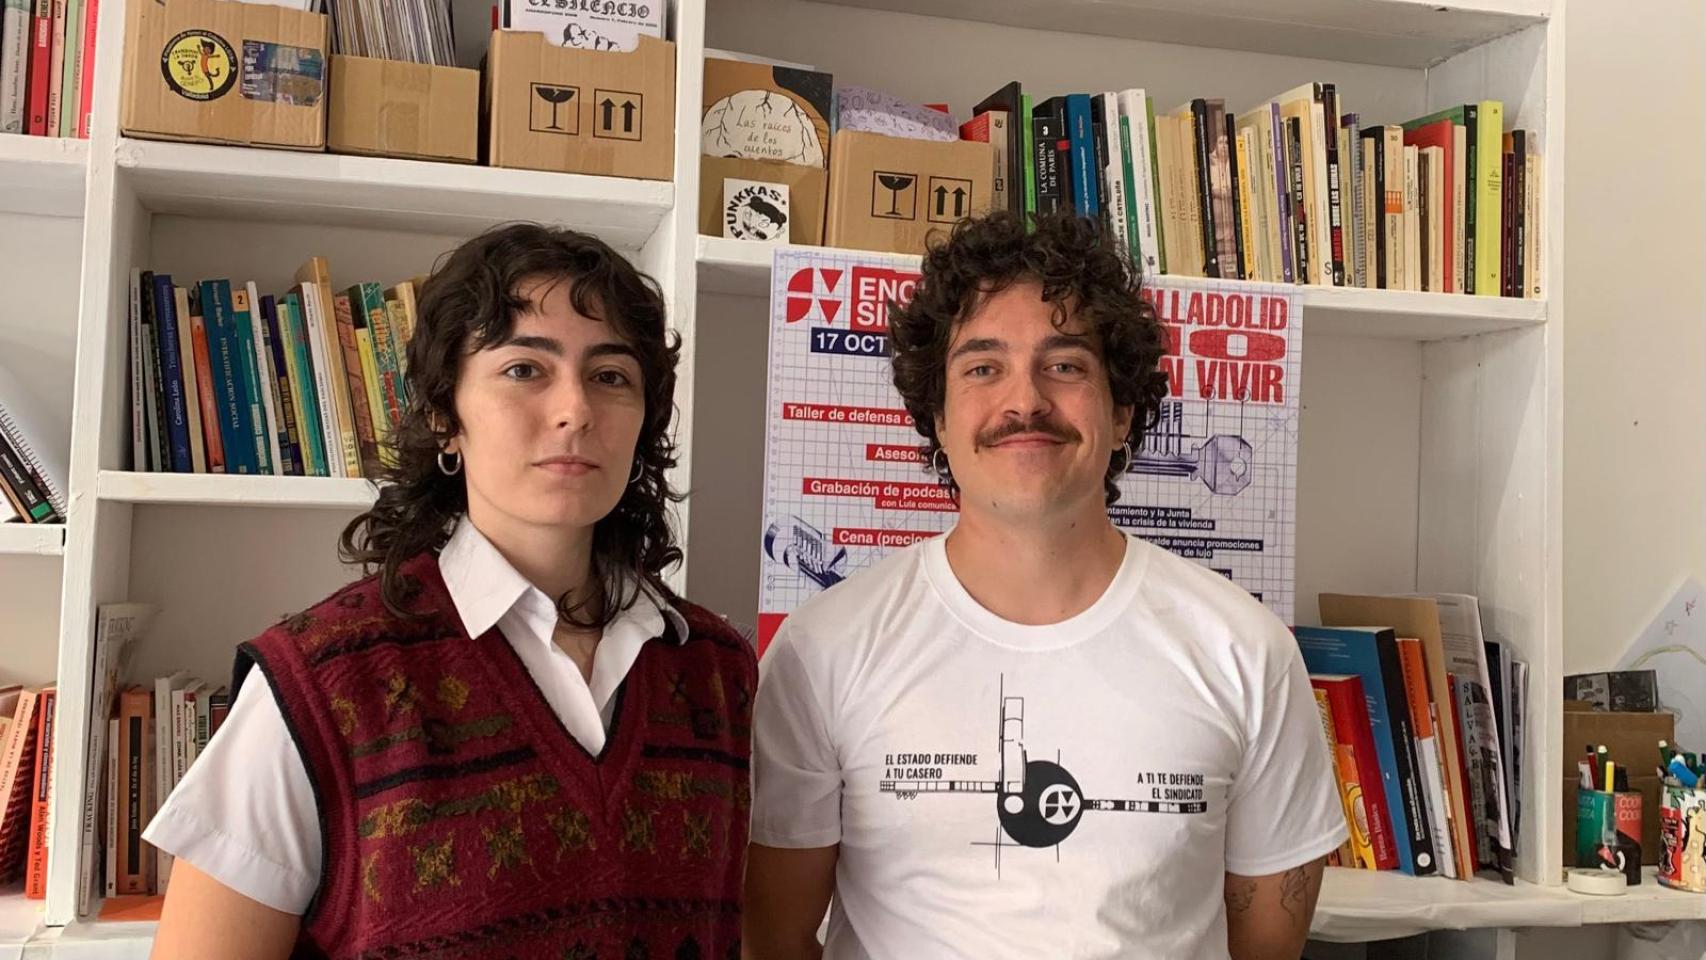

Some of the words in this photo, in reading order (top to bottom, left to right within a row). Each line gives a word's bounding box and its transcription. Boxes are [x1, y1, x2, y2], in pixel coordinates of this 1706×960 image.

[736, 106, 756, 129] Las
[747, 132, 759, 142] de
[763, 135, 777, 145] los
[1039, 142, 1048, 180] COMUNA
[1048, 149, 1057, 172] PARÍS
[1041, 182, 1048, 193] LA
[1050, 175, 1057, 187] DE
[1330, 190, 1339, 203] LAS
[726, 186, 782, 240] PUNKKAS
[859, 277, 917, 302] ENC
[237, 294, 245, 305] 2
[857, 303, 886, 327] SI
[816, 333, 838, 350] 17
[844, 334, 888, 353] OCT
[170, 379, 180, 397] León
[1159, 358, 1184, 398] N
[1196, 359, 1284, 403] VIVIR
[172, 397, 183, 426] Carolina
[230, 402, 240, 430] SOCIAL
[787, 405, 825, 420] Taller
[828, 408, 845, 421] de
[849, 409, 901, 424] defensa
[904, 415, 914, 424] c
[874, 448, 920, 462] Aseso
[810, 480, 879, 496] Grabación
[883, 483, 899, 497] de
[903, 485, 955, 500] podcas
[881, 500, 897, 508] con
[1107, 507, 1148, 517] ntamiento
[1149, 510, 1156, 518] y
[1157, 509, 1165, 517] la
[1166, 509, 1190, 518] Junta
[1122, 516, 1130, 525] la
[1131, 517, 1156, 526] crisis
[1156, 518, 1168, 527] de
[1168, 518, 1177, 527] la
[1178, 519, 1213, 529] vivienda
[838, 530, 873, 545] Cena
[876, 531, 930, 547] (precio
[1172, 539, 1205, 548] anuncia
[1206, 540, 1260, 550] promociones
[1184, 548, 1194, 557] de
[1196, 549, 1212, 559] lujo
[885, 753, 894, 766] EL
[898, 753, 932, 766] ESTADO
[934, 753, 978, 766] DEFIENDE
[885, 768, 891, 779] A
[893, 768, 904, 779] TU
[906, 767, 943, 780] CASERO
[1136, 772, 1144, 785] A
[1146, 773, 1156, 785] TI
[1157, 773, 1168, 785] TE
[1169, 773, 1204, 786] DEFIENDE
[1152, 787, 1163, 799] EL
[1164, 787, 1203, 800] SINDICATO
[36, 805, 45, 823] Alan
[84, 791, 95, 833] FRACKING
[34, 824, 43, 850] Woods
[1375, 832, 1388, 861] Renta
[33, 856, 41, 871] Ted
[31, 872, 40, 895] Grant
